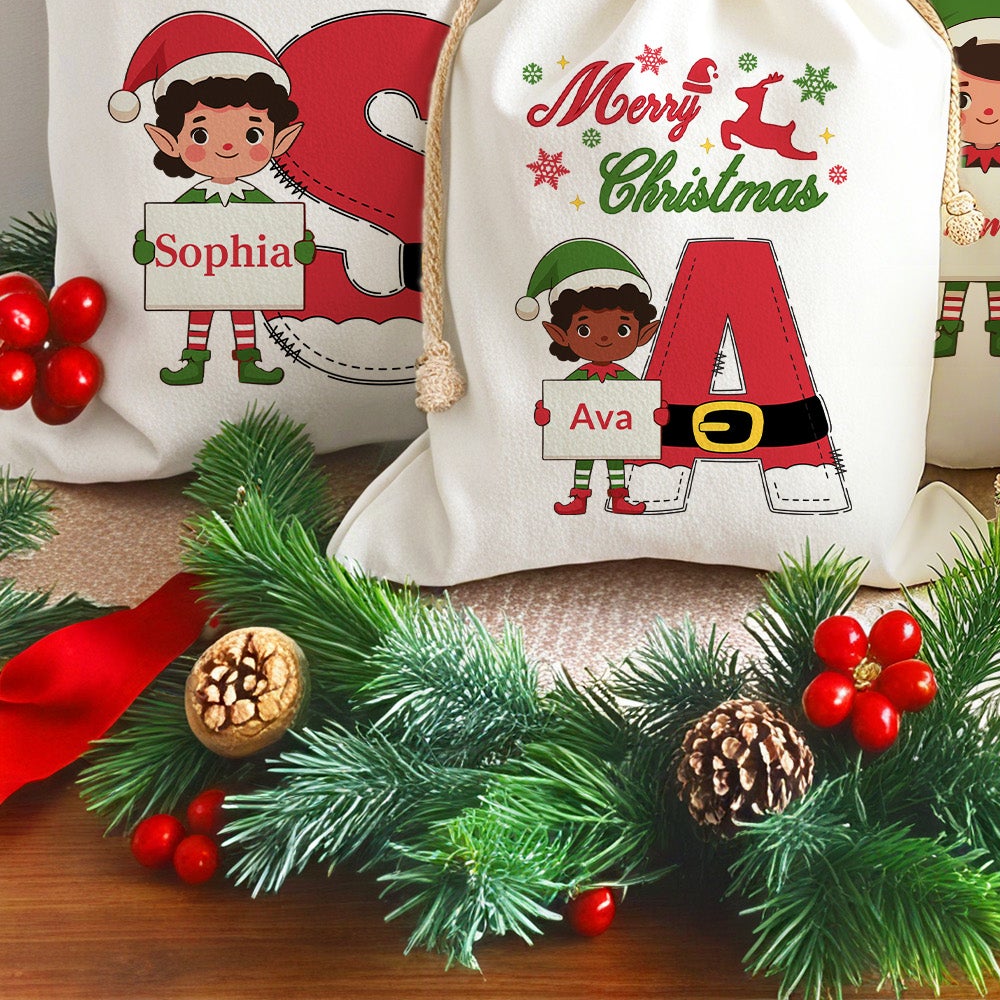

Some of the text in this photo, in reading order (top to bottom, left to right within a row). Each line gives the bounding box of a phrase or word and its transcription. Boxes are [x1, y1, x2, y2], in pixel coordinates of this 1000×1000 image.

[526, 59, 702, 143] Merry
[599, 147, 829, 215] Christmas
[154, 232, 294, 278] Sophia
[568, 402, 634, 431] Ava
